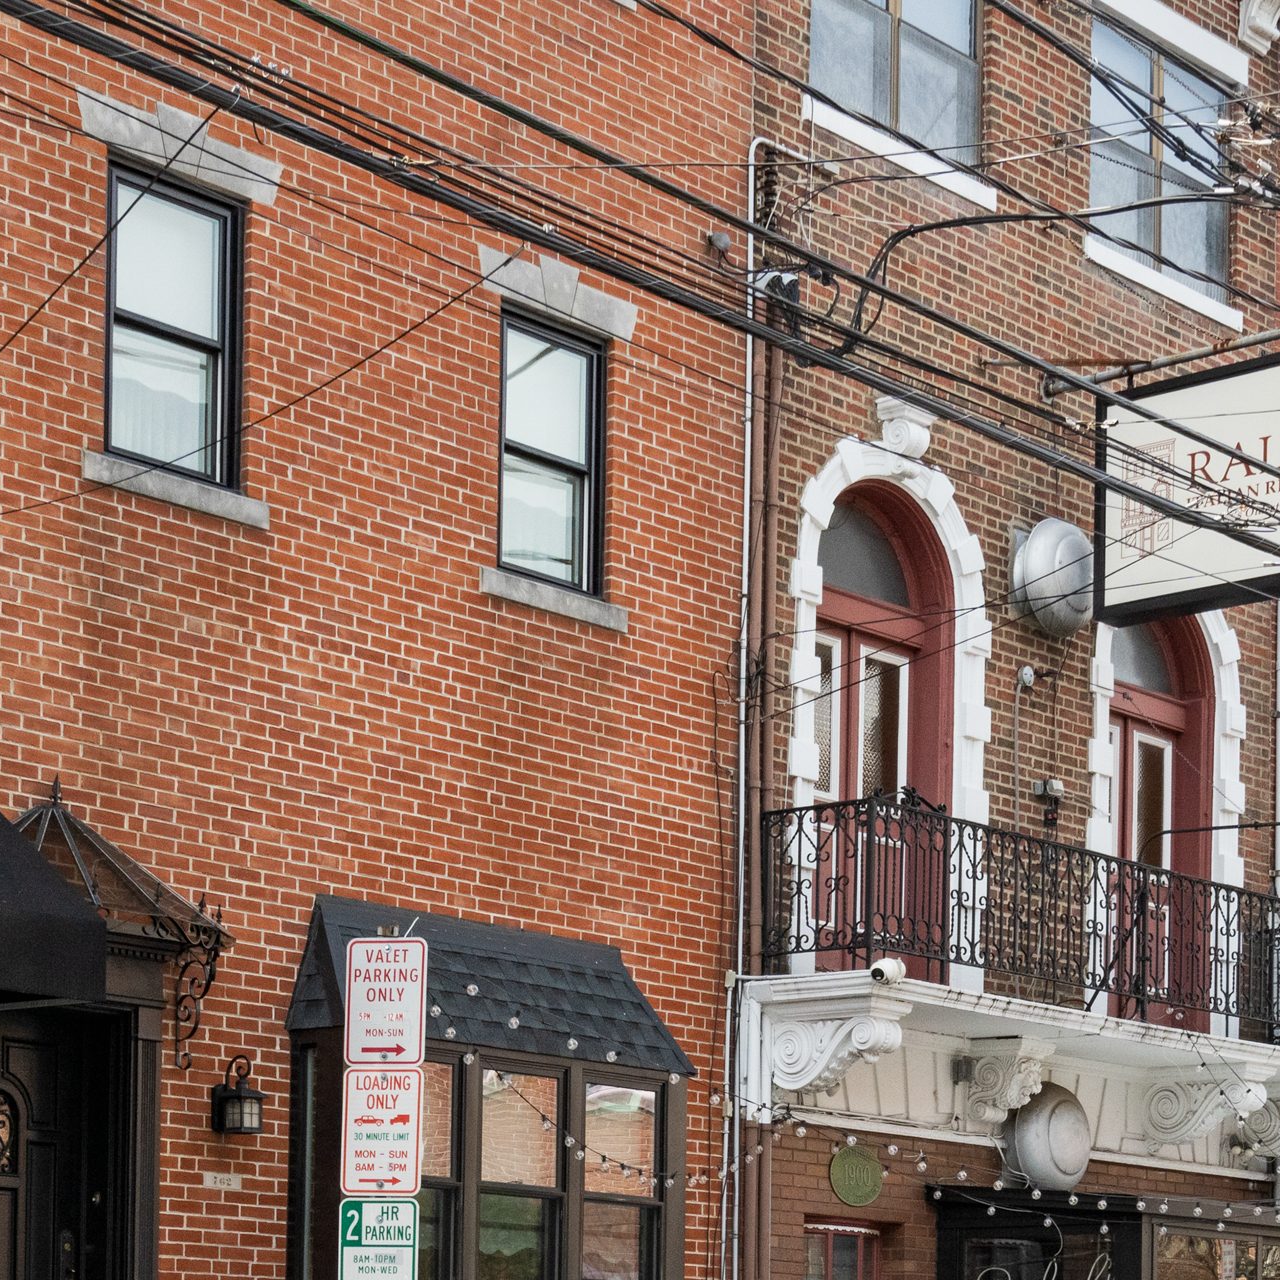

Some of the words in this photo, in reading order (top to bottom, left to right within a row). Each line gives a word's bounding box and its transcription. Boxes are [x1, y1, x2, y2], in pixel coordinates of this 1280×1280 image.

[365, 949, 409, 963] VALET
[354, 968, 419, 983] PARKING
[366, 988, 404, 1002] ONLY
[365, 1028, 404, 1037] MON-SUN
[356, 1075, 411, 1091] LOADING
[366, 1094, 399, 1110] ONLY
[354, 1133, 363, 1141] 30
[366, 1133, 390, 1141] MINUTE
[393, 1133, 410, 1141] LIMIT
[354, 1150, 376, 1158] MON
[389, 1150, 408, 1158] SUN
[355, 1163, 375, 1171] 8AM
[389, 1163, 407, 1171] 5PM
[346, 1209, 359, 1241] 2
[381, 1206, 399, 1221] HR
[365, 1225, 412, 1241] PARKING
[353, 1255, 396, 1263] 8AM-10PM
[358, 1266, 398, 1274] MON-WED
